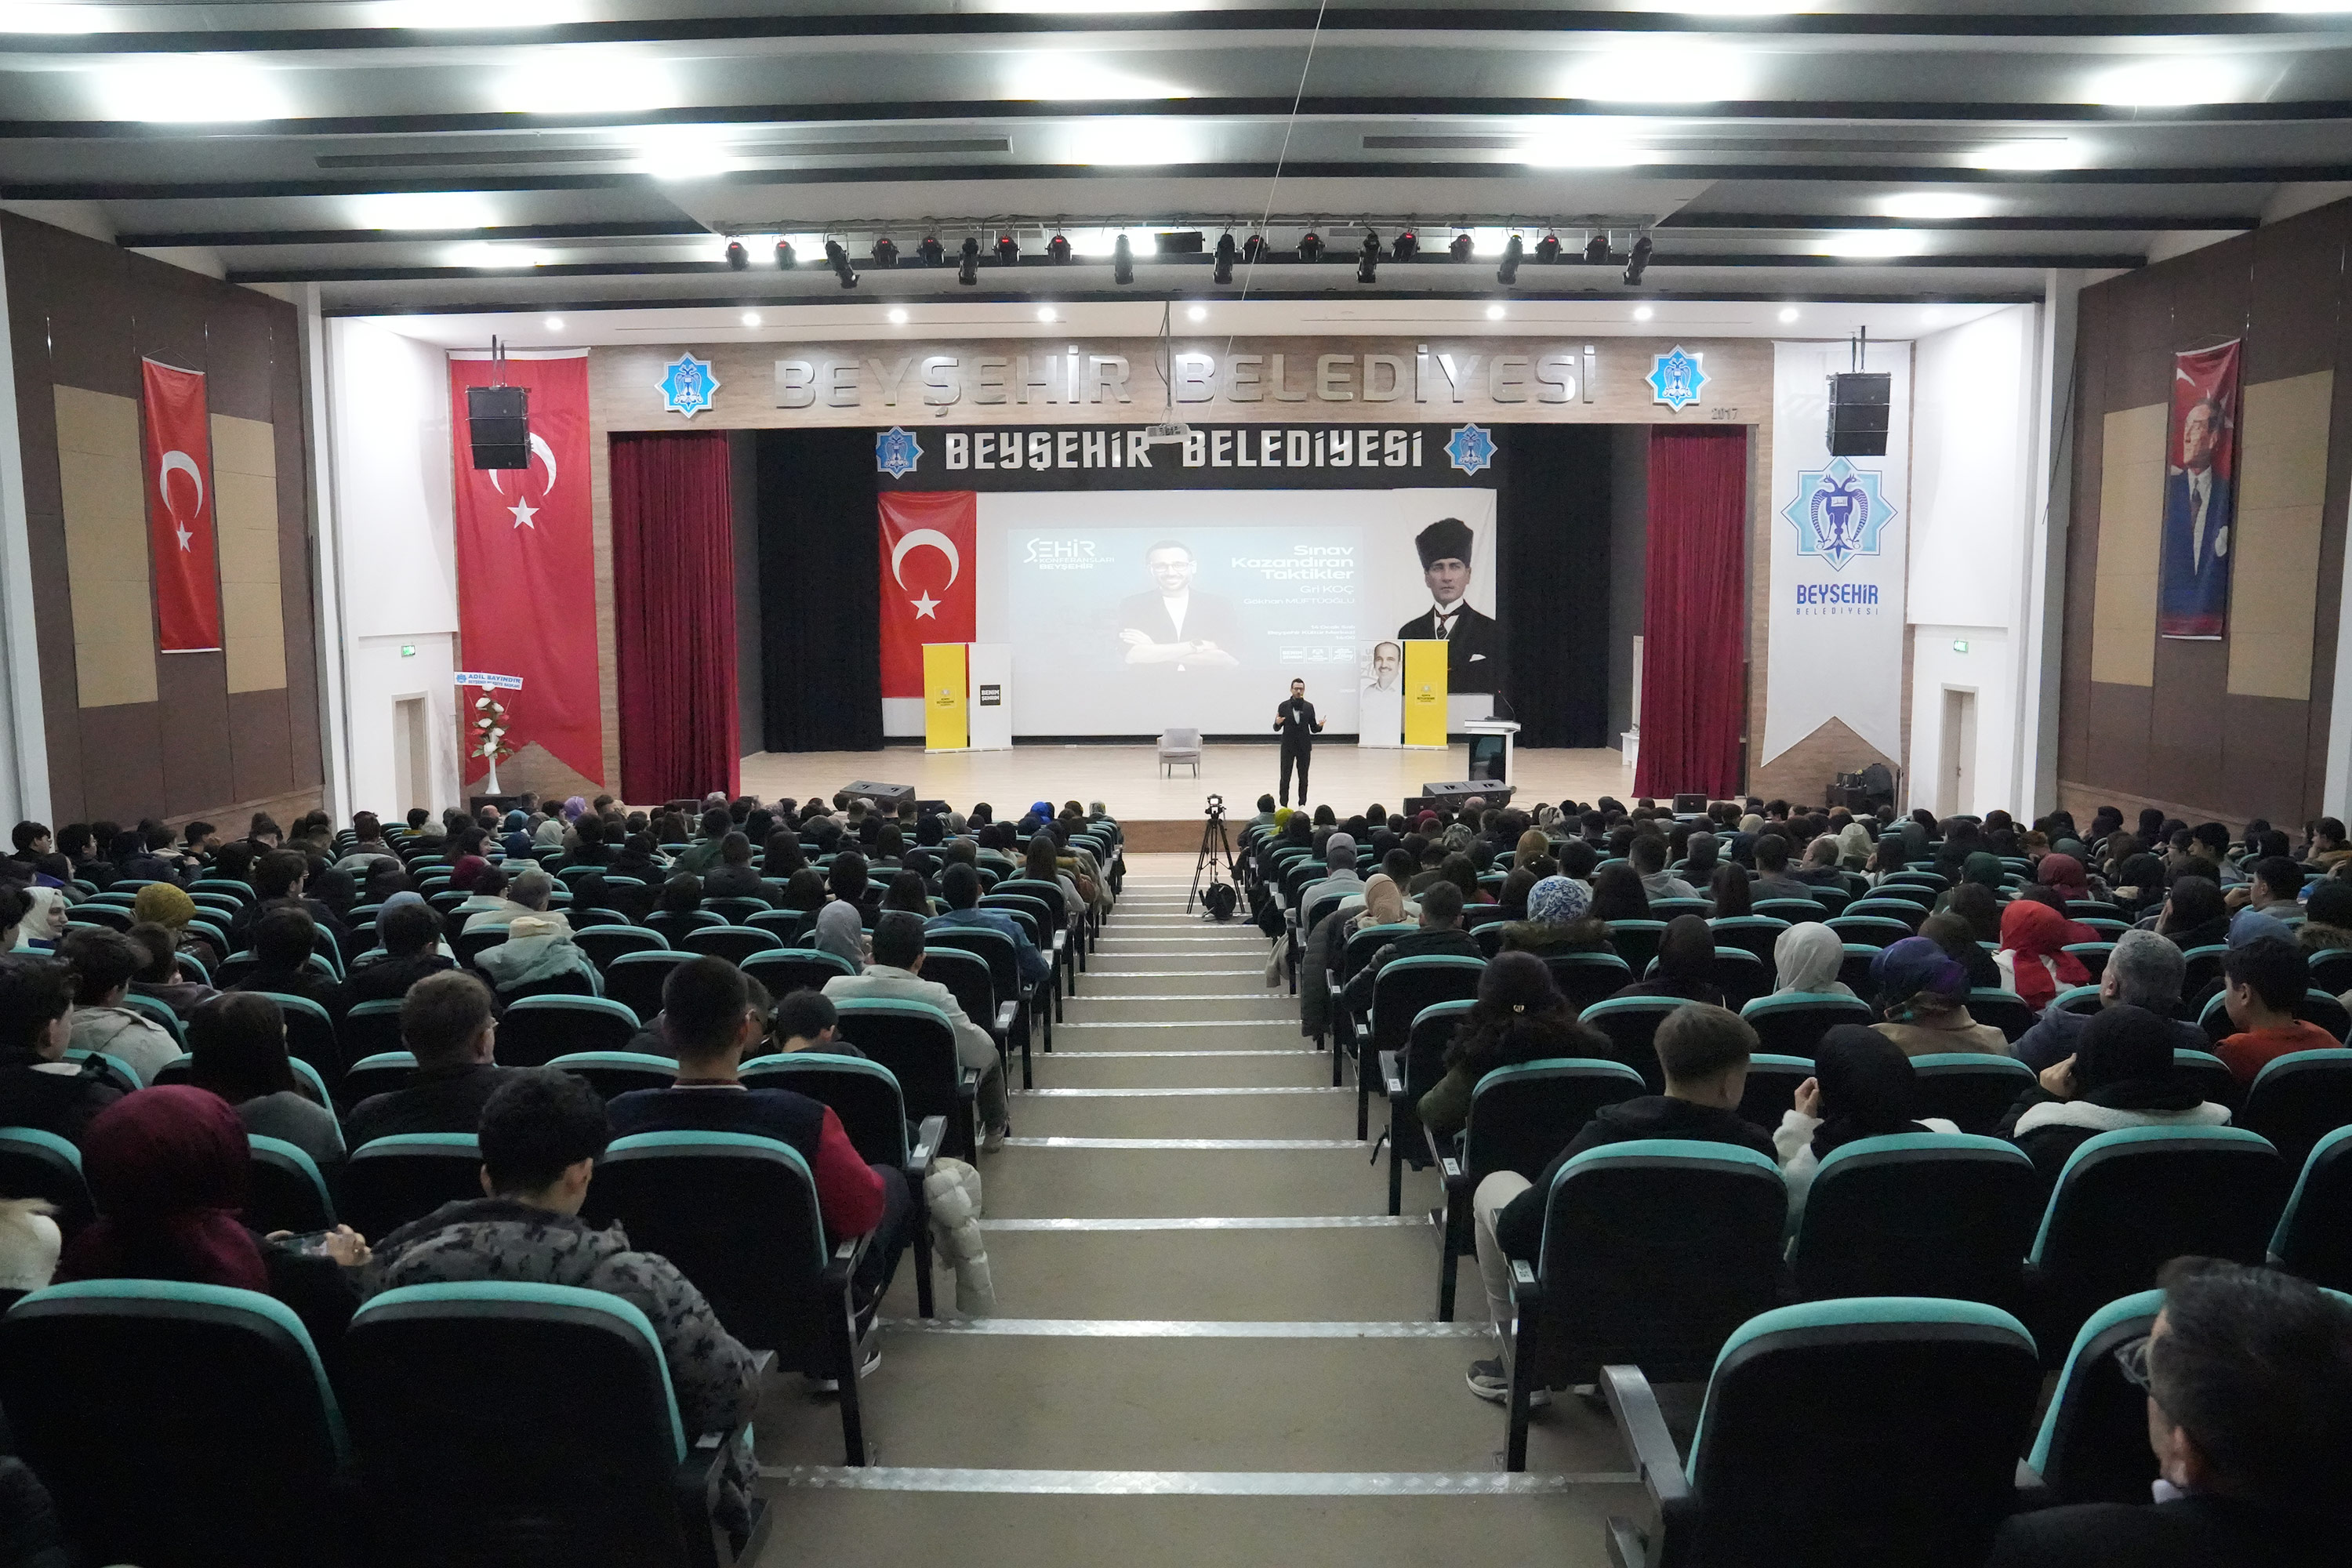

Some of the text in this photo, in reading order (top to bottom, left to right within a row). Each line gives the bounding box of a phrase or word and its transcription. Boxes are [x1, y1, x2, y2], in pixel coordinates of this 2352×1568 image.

[775, 344, 1595, 418] BEYŞEHİR BELEDİYESİ
[1711, 408, 1737, 419] 2017
[946, 430, 1423, 471] BEYŞEHİR BELEDİYESİ
[1023, 538, 1096, 563] ŞEHİR
[1294, 545, 1354, 555] Sınav
[1231, 557, 1354, 568] Kazandıran
[1261, 568, 1354, 579] Taktikler
[1323, 585, 1354, 594] KOÇ
[1797, 583, 1878, 604] BEYŞEHİR
